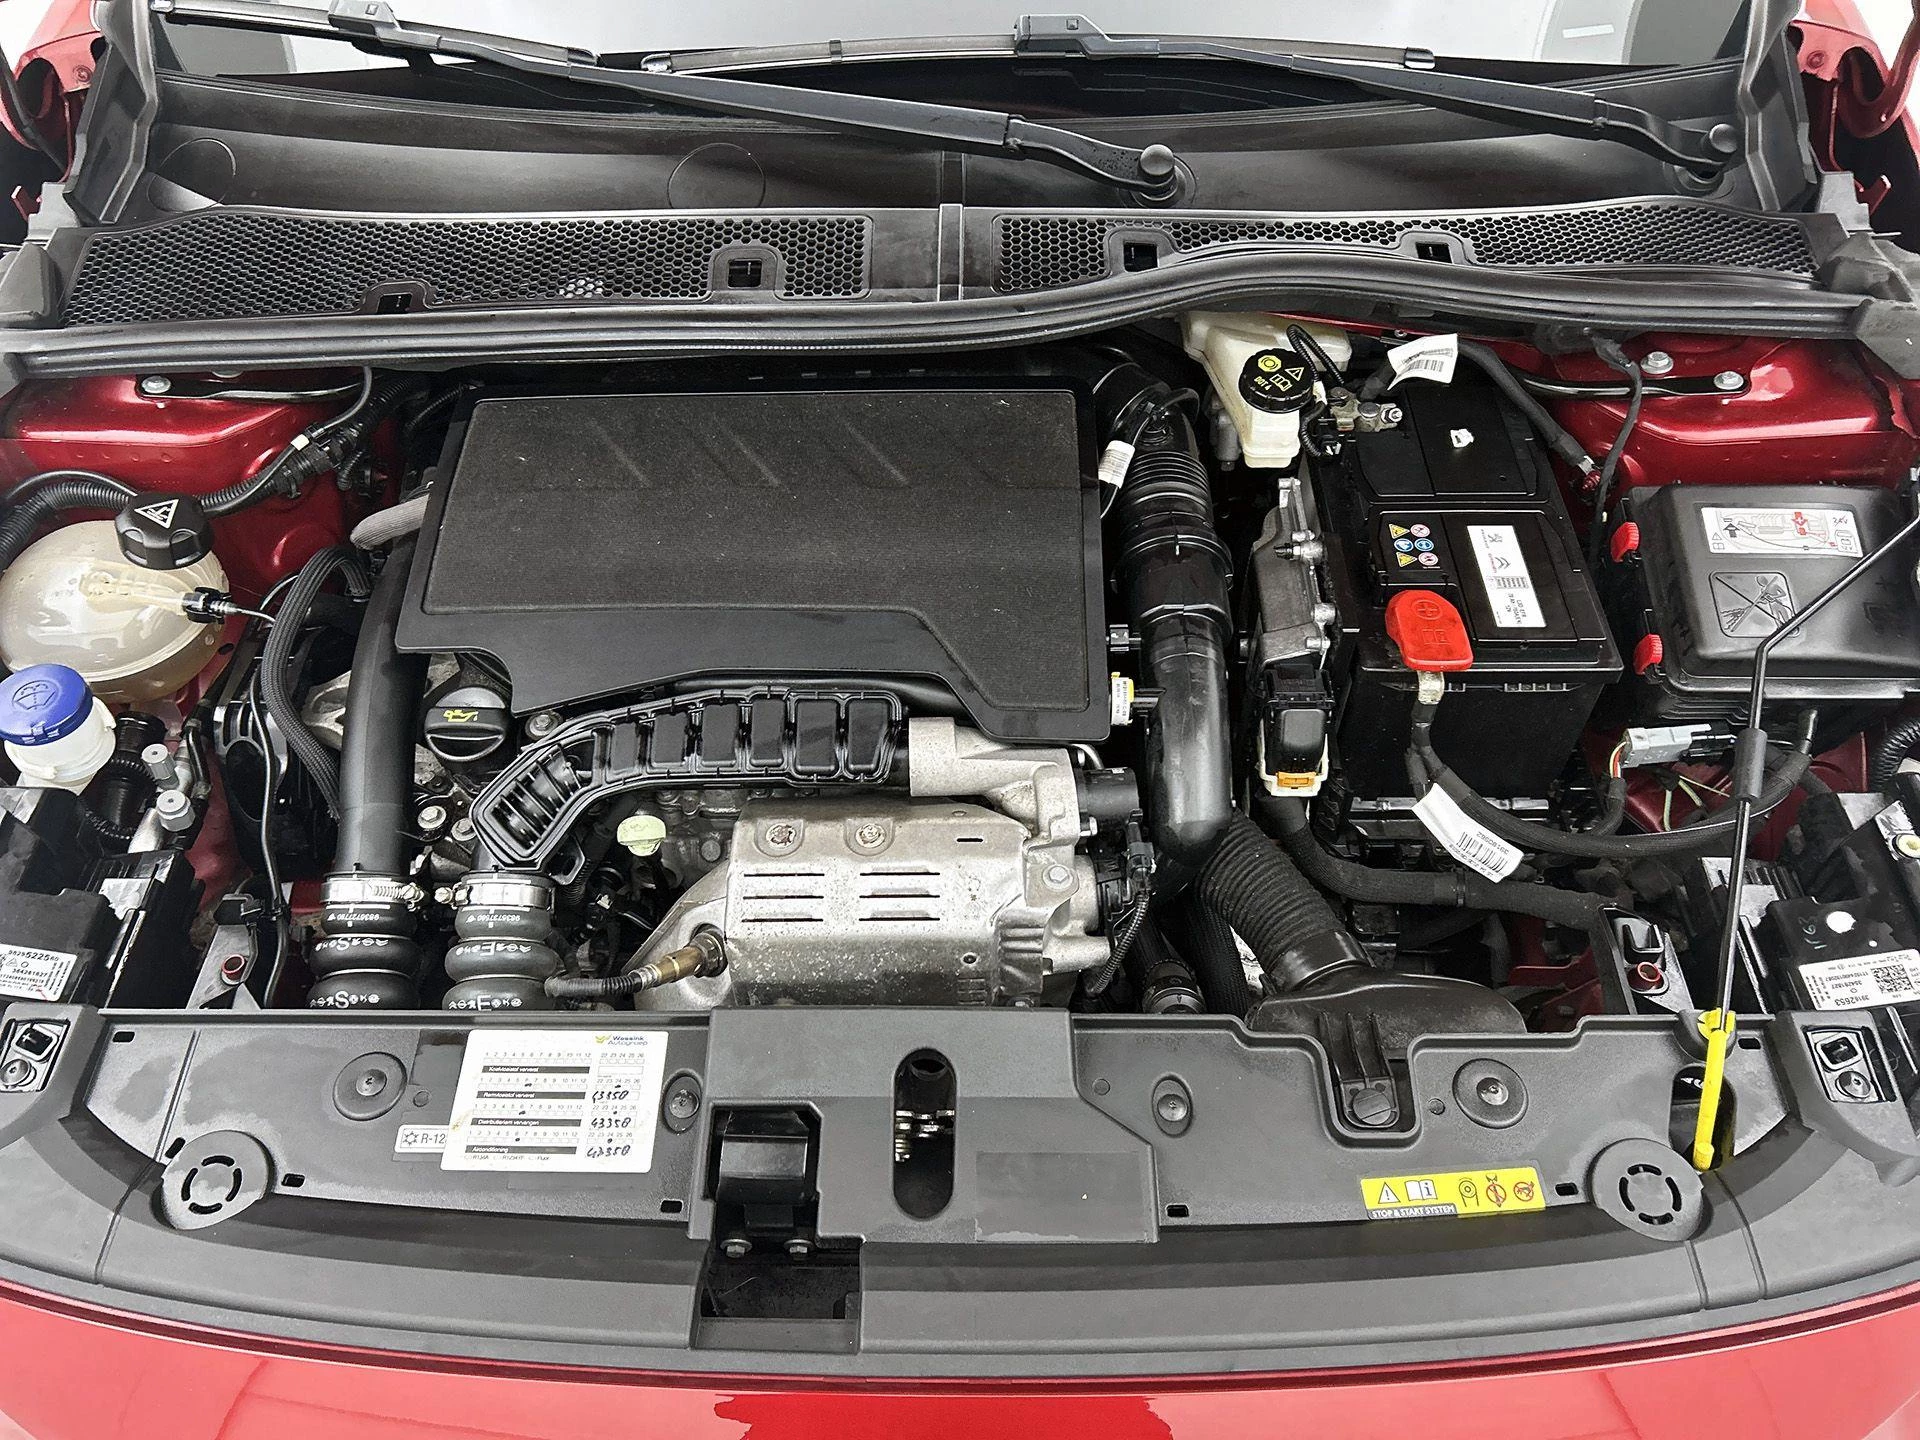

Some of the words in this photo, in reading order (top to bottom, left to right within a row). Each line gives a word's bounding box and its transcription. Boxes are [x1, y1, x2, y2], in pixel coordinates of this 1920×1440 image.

[1254, 376, 1268, 389] DOT
[591, 1117, 631, 1128] 43350
[421, 1133, 447, 1144] R-12
[1372, 1209, 1393, 1218] STOP
[1400, 1207, 1424, 1216] START
[1425, 1205, 1455, 1214] SYSTEM
